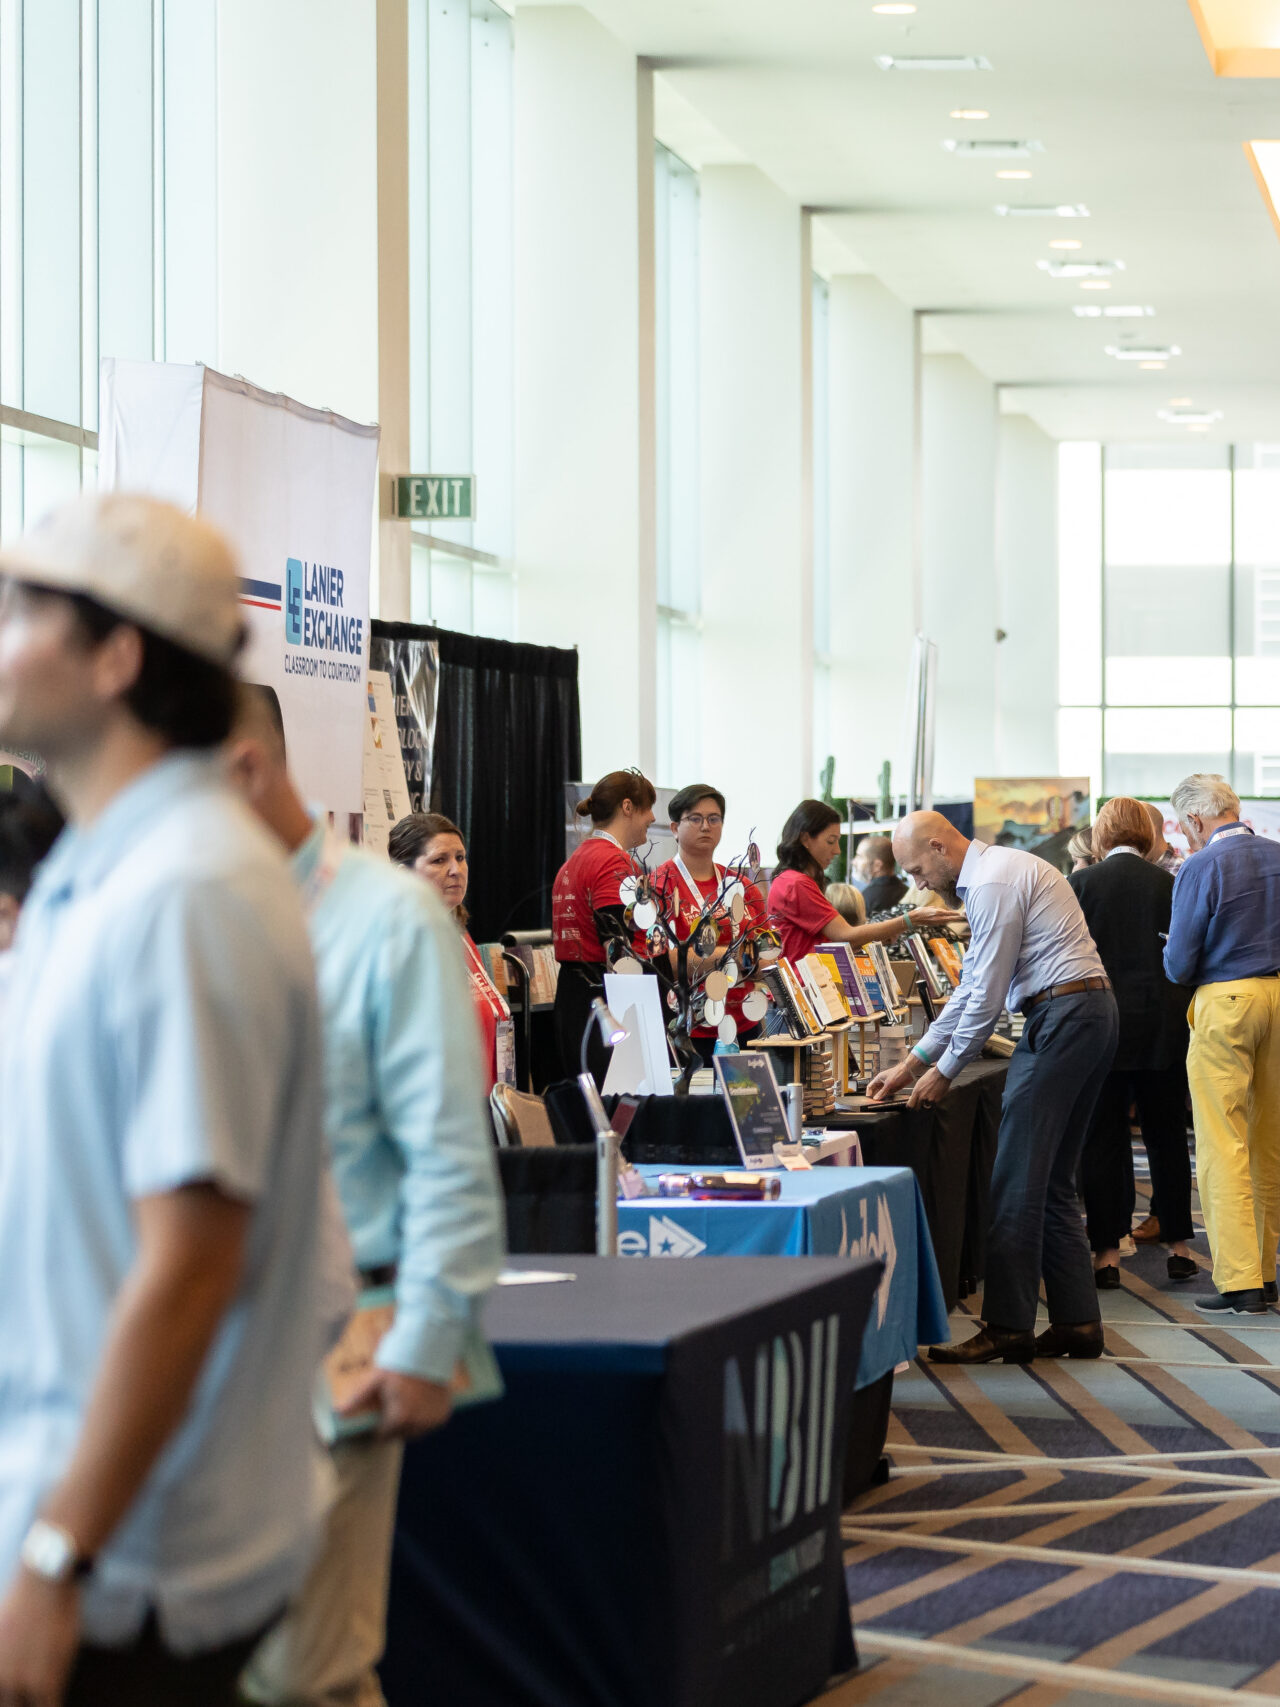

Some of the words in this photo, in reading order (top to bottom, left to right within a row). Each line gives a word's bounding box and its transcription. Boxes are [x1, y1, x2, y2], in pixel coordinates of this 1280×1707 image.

[410, 480, 464, 516] EXIT
[304, 561, 344, 608] LANIER
[303, 607, 362, 656] EXCHANGE
[285, 654, 319, 678] CLASSROOM
[319, 660, 327, 679] TO
[328, 660, 361, 683] COURTROOM
